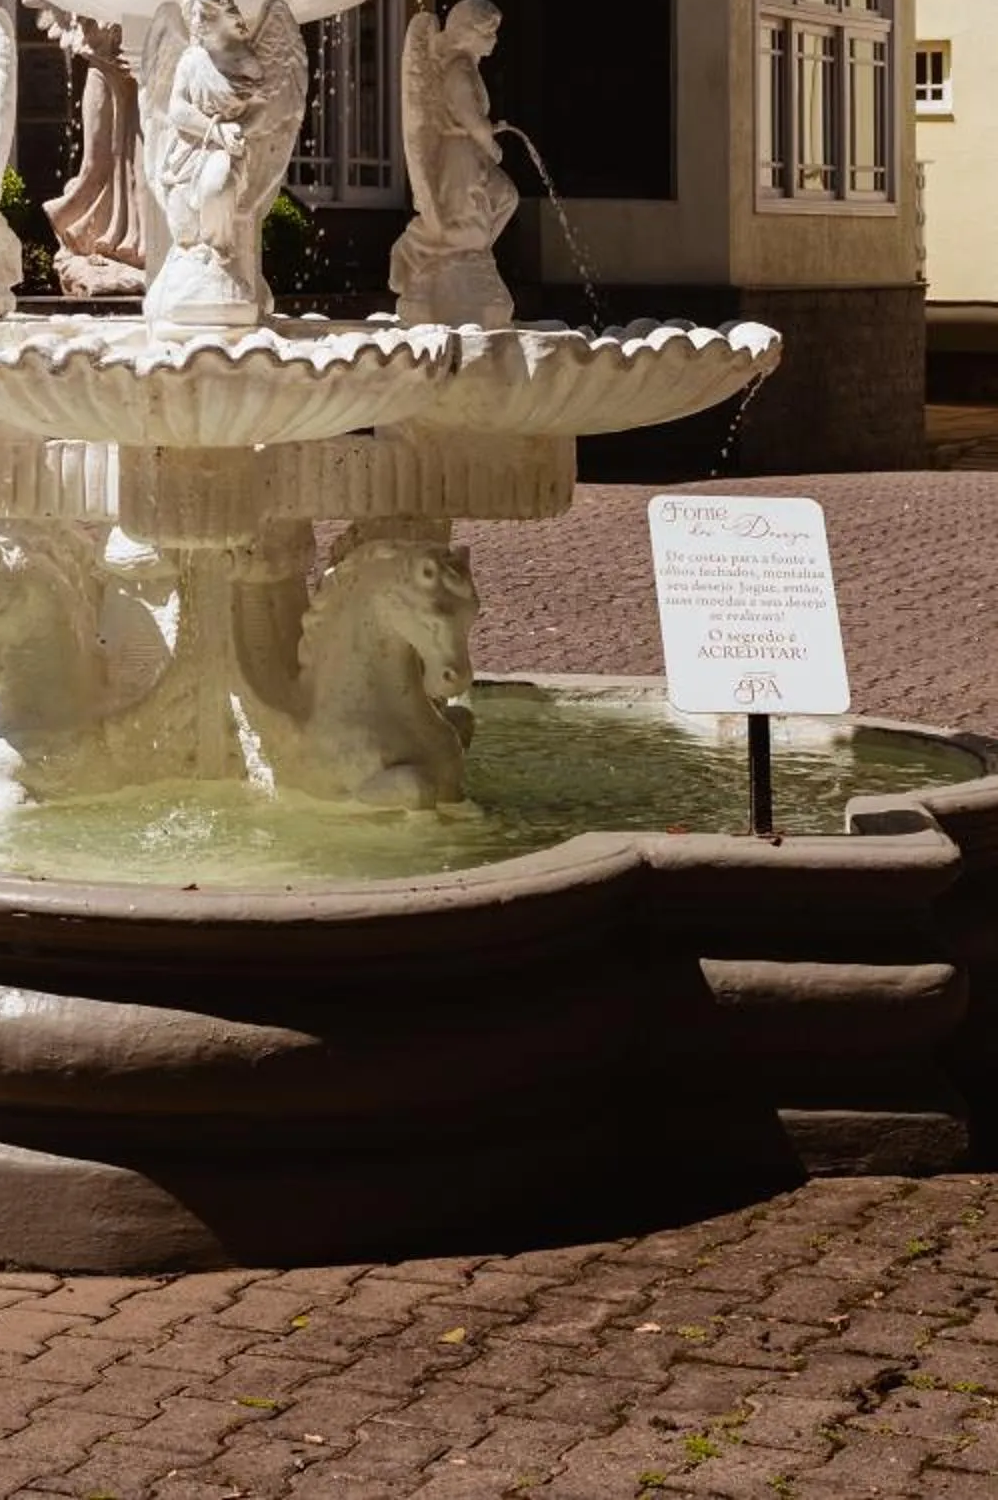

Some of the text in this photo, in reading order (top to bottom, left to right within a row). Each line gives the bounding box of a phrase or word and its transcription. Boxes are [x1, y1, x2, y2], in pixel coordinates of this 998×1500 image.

[731, 553, 759, 567] para
[708, 628, 723, 642] O
[697, 644, 808, 661] ACREDITAR!
